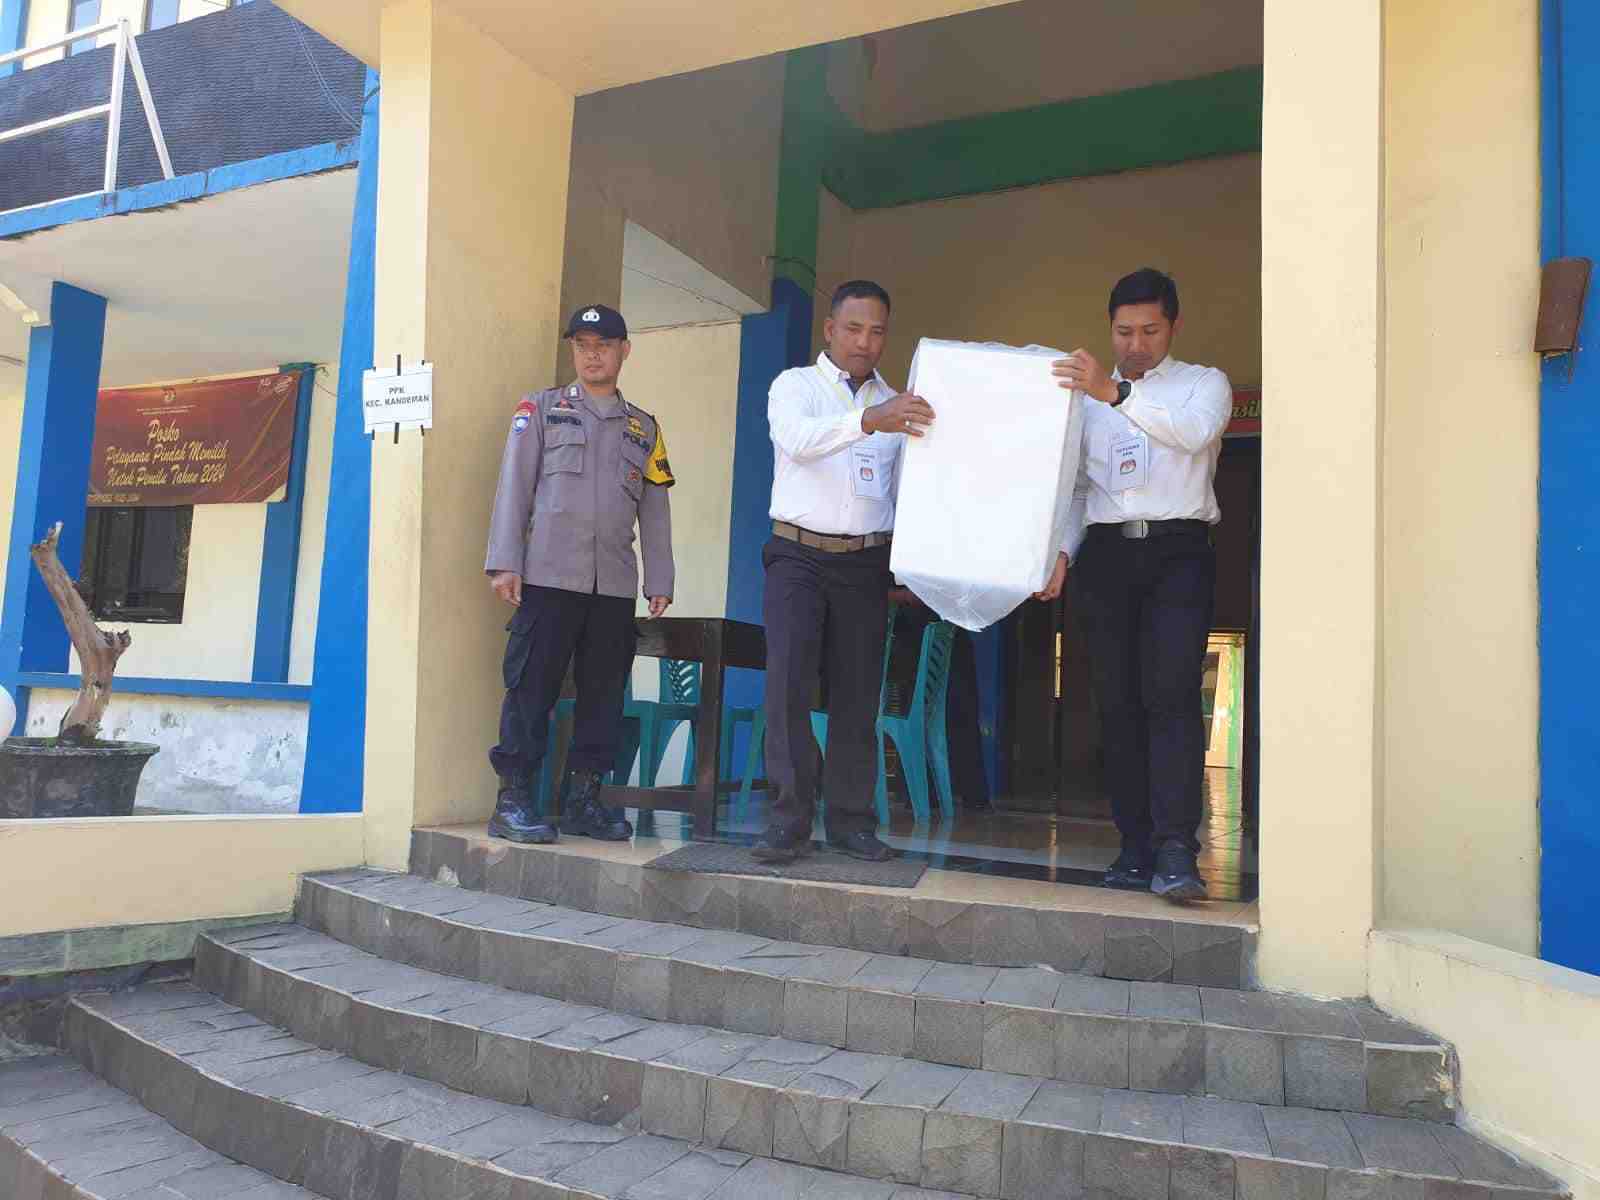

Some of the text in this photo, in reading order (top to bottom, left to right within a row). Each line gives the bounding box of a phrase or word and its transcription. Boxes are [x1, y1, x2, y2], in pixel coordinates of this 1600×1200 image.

[388, 386, 405, 395] PPK
[365, 399, 383, 408] KEC.
[146, 418, 180, 446] Posko
[152, 442, 186, 464] Pindah
[170, 463, 199, 484] Tahun
[201, 462, 226, 483] 2024
